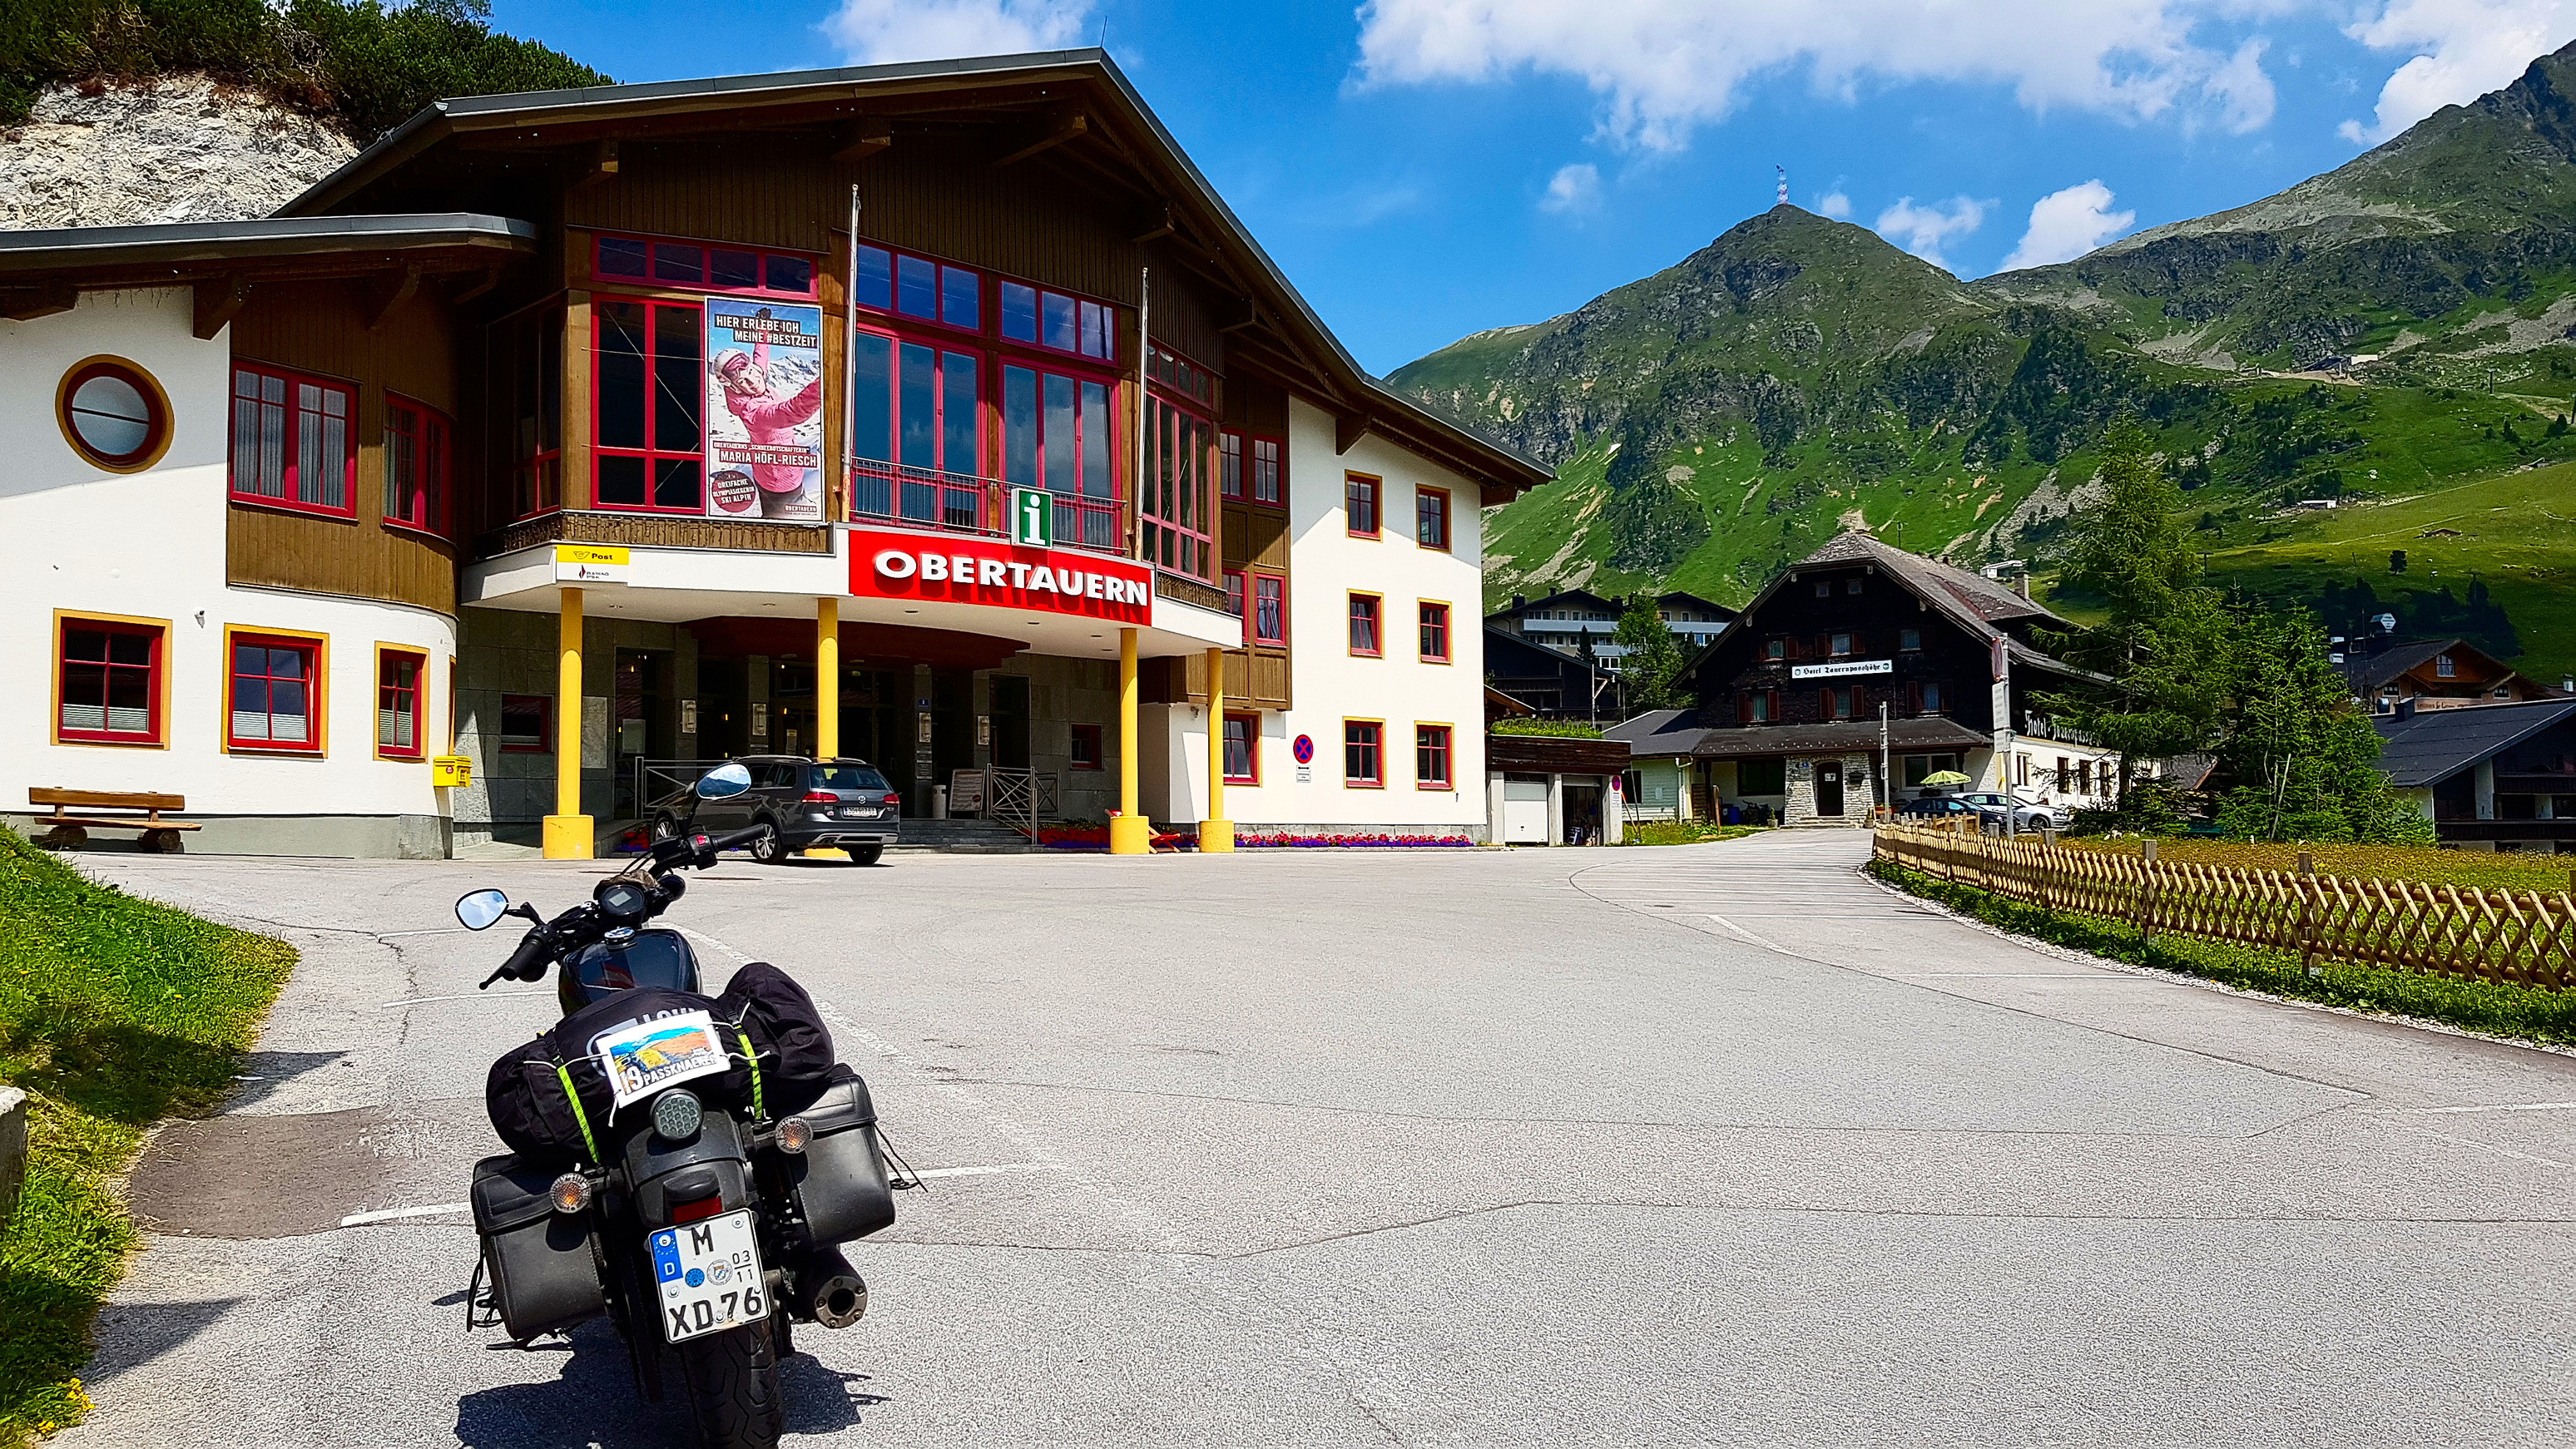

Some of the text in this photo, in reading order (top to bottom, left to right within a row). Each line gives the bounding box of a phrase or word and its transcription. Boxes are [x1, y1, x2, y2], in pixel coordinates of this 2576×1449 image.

[716, 315, 799, 334] HIER ERLEBE ICH
[734, 330, 816, 348] MEINE #BESTZEIT
[721, 451, 816, 467] MARIA HÖFL-RIESCH
[717, 478, 749, 489] DREIFACHE
[721, 495, 732, 504] SKI
[592, 552, 613, 561] Post
[874, 550, 1148, 606] OBERTAUERN
[691, 1224, 714, 1256] M
[731, 1249, 751, 1264] 03
[664, 1262, 676, 1276] D
[736, 1268, 754, 1283] 11
[669, 1287, 762, 1338] XD 76
